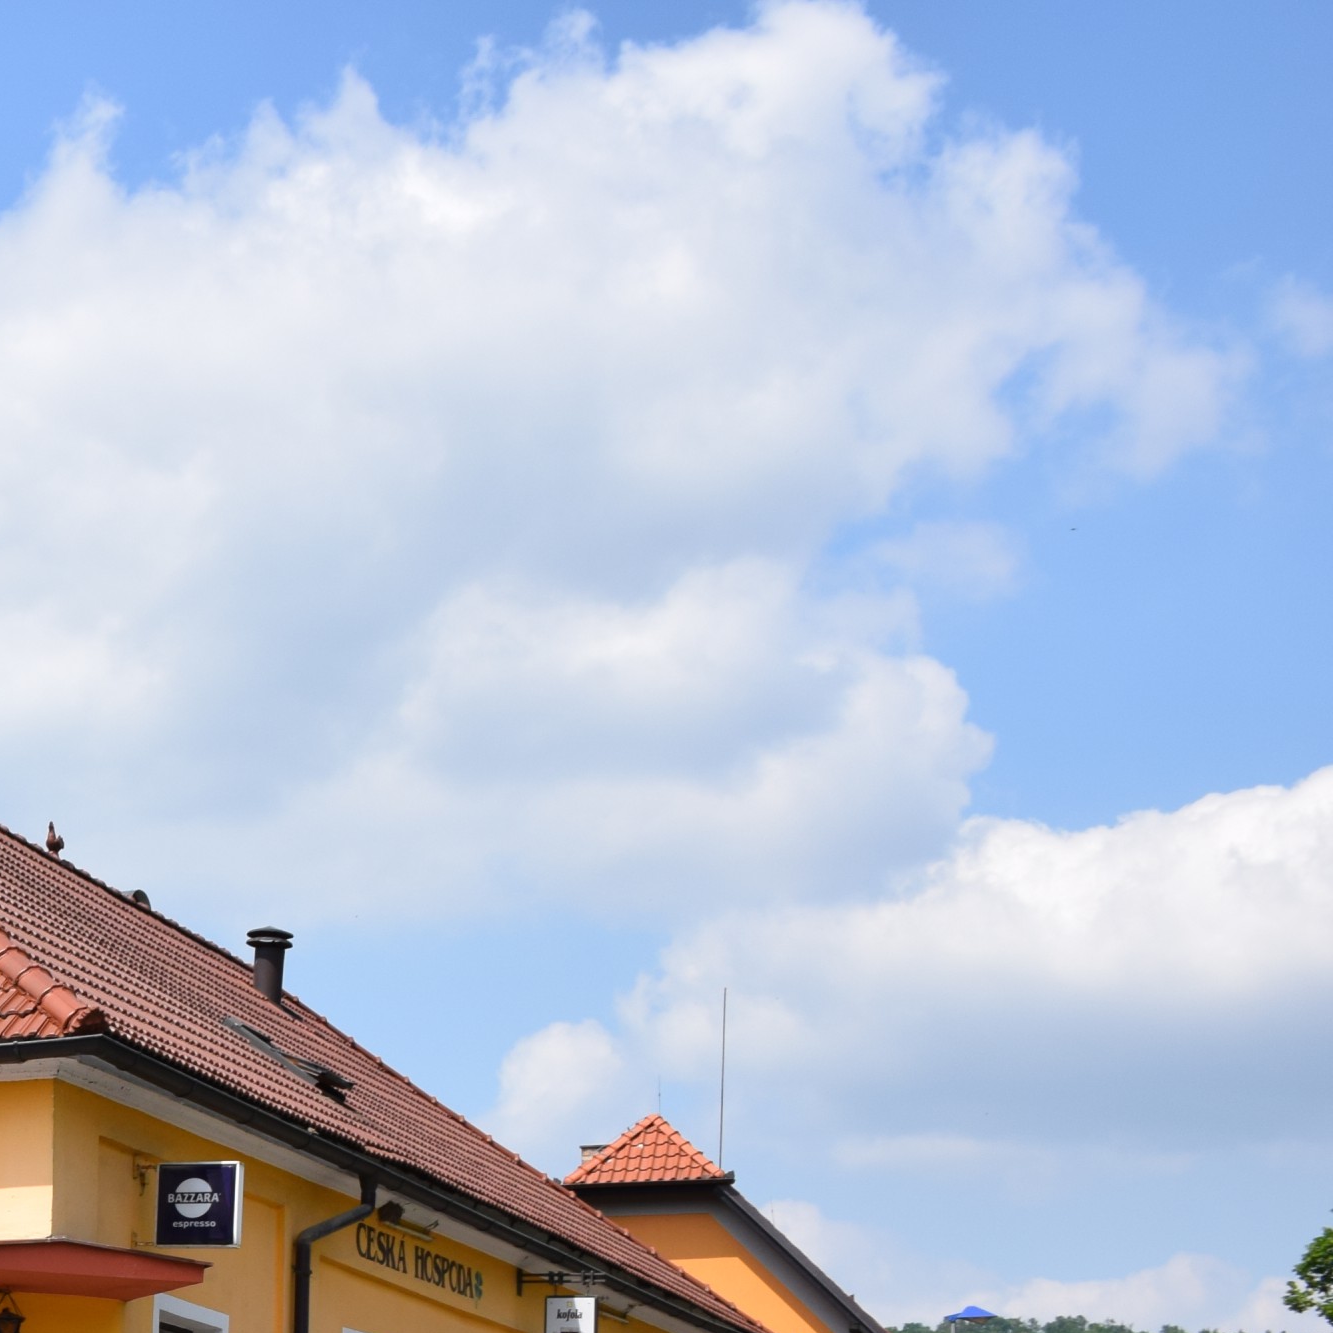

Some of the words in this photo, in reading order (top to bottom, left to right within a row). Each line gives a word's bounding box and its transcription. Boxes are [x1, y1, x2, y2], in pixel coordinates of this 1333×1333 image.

[168, 1192, 220, 1203] BAZZARA
[172, 1221, 217, 1229] espresso
[414, 1244, 474, 1299] HOSPODA
[556, 1308, 583, 1322] kofola
